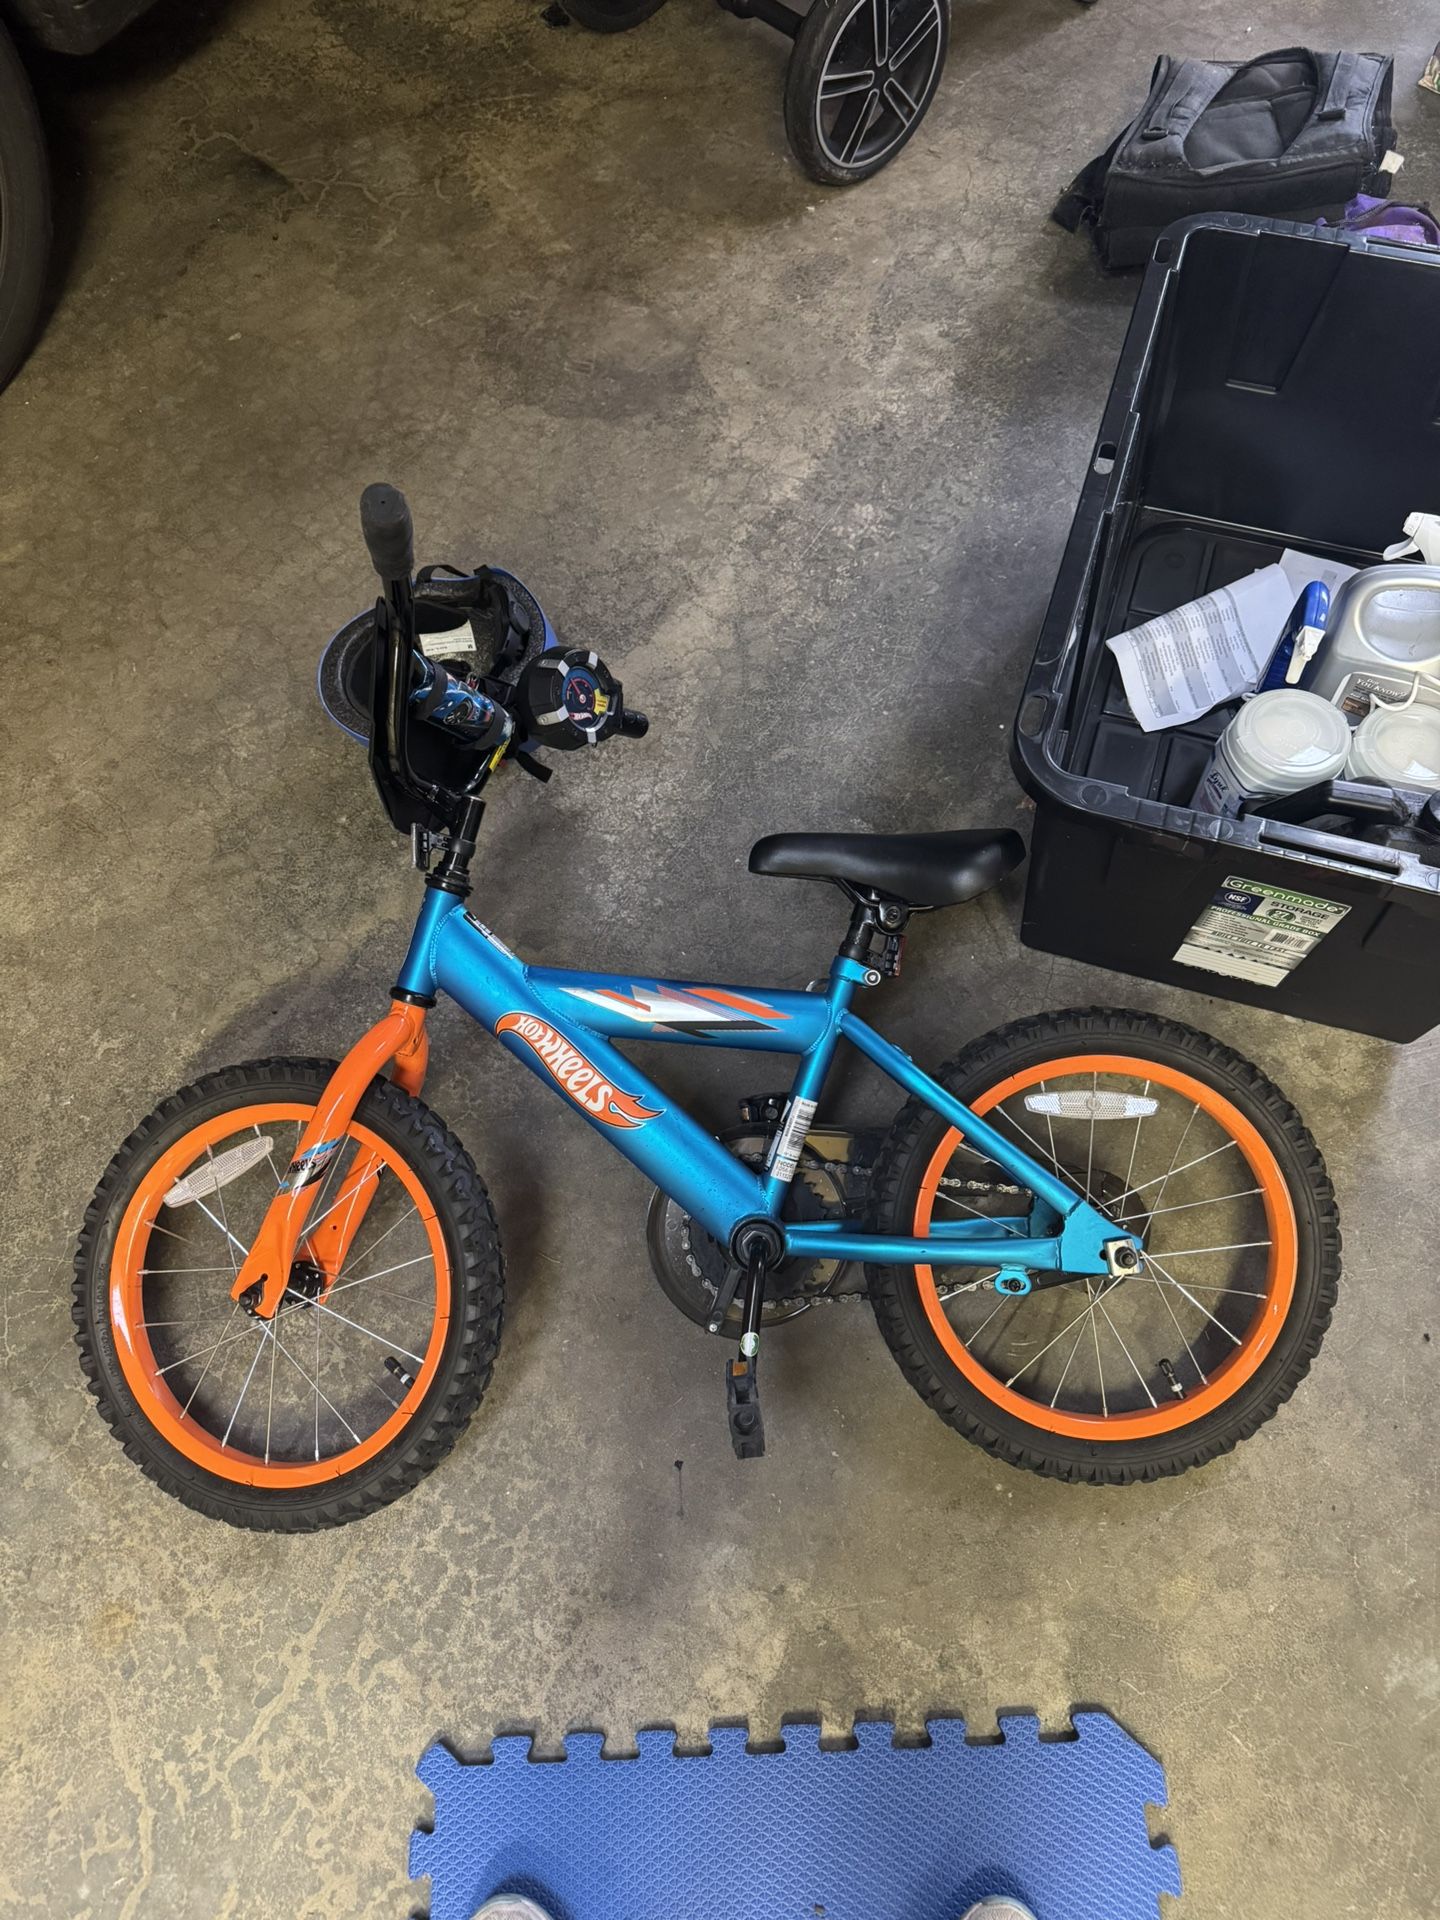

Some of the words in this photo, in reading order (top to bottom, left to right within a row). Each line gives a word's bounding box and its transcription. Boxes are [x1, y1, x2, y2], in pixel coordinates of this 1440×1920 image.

[1356, 678, 1374, 689] YOU
[1374, 685, 1408, 697] KNOW?
[1227, 893, 1248, 903] NSF
[1229, 879, 1338, 913] Greenmade
[1270, 901, 1330, 920] STORAGE
[1210, 905, 1271, 925] PROFESSIONAL
[1272, 920, 1302, 932] GRADE
[1302, 928, 1321, 938] BOX
